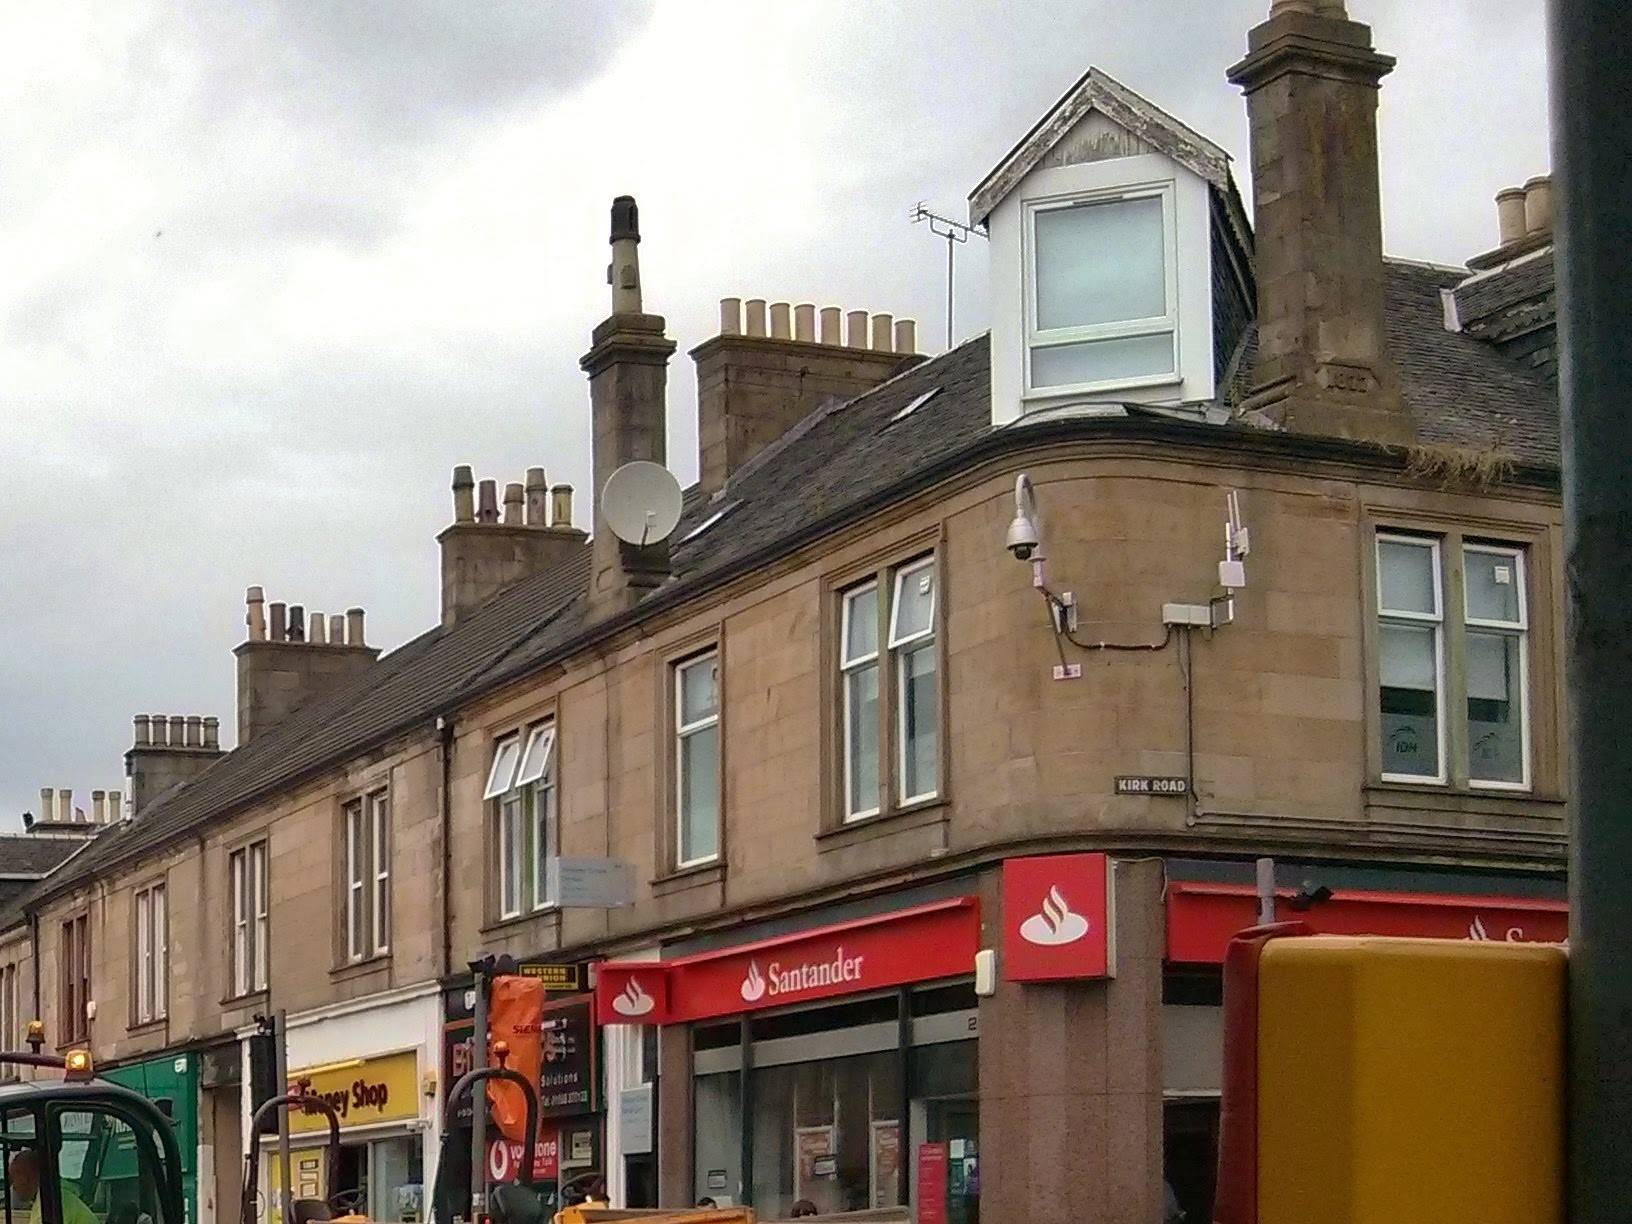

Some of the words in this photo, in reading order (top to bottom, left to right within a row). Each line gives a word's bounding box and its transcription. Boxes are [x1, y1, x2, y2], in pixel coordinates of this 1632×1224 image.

[1118, 779, 1149, 792] KIRK
[1152, 780, 1186, 792] ROAD
[523, 967, 566, 975] WESTERN
[768, 944, 864, 996] Santander
[352, 1078, 388, 1114] Shop
[509, 1142, 557, 1161] vofone
